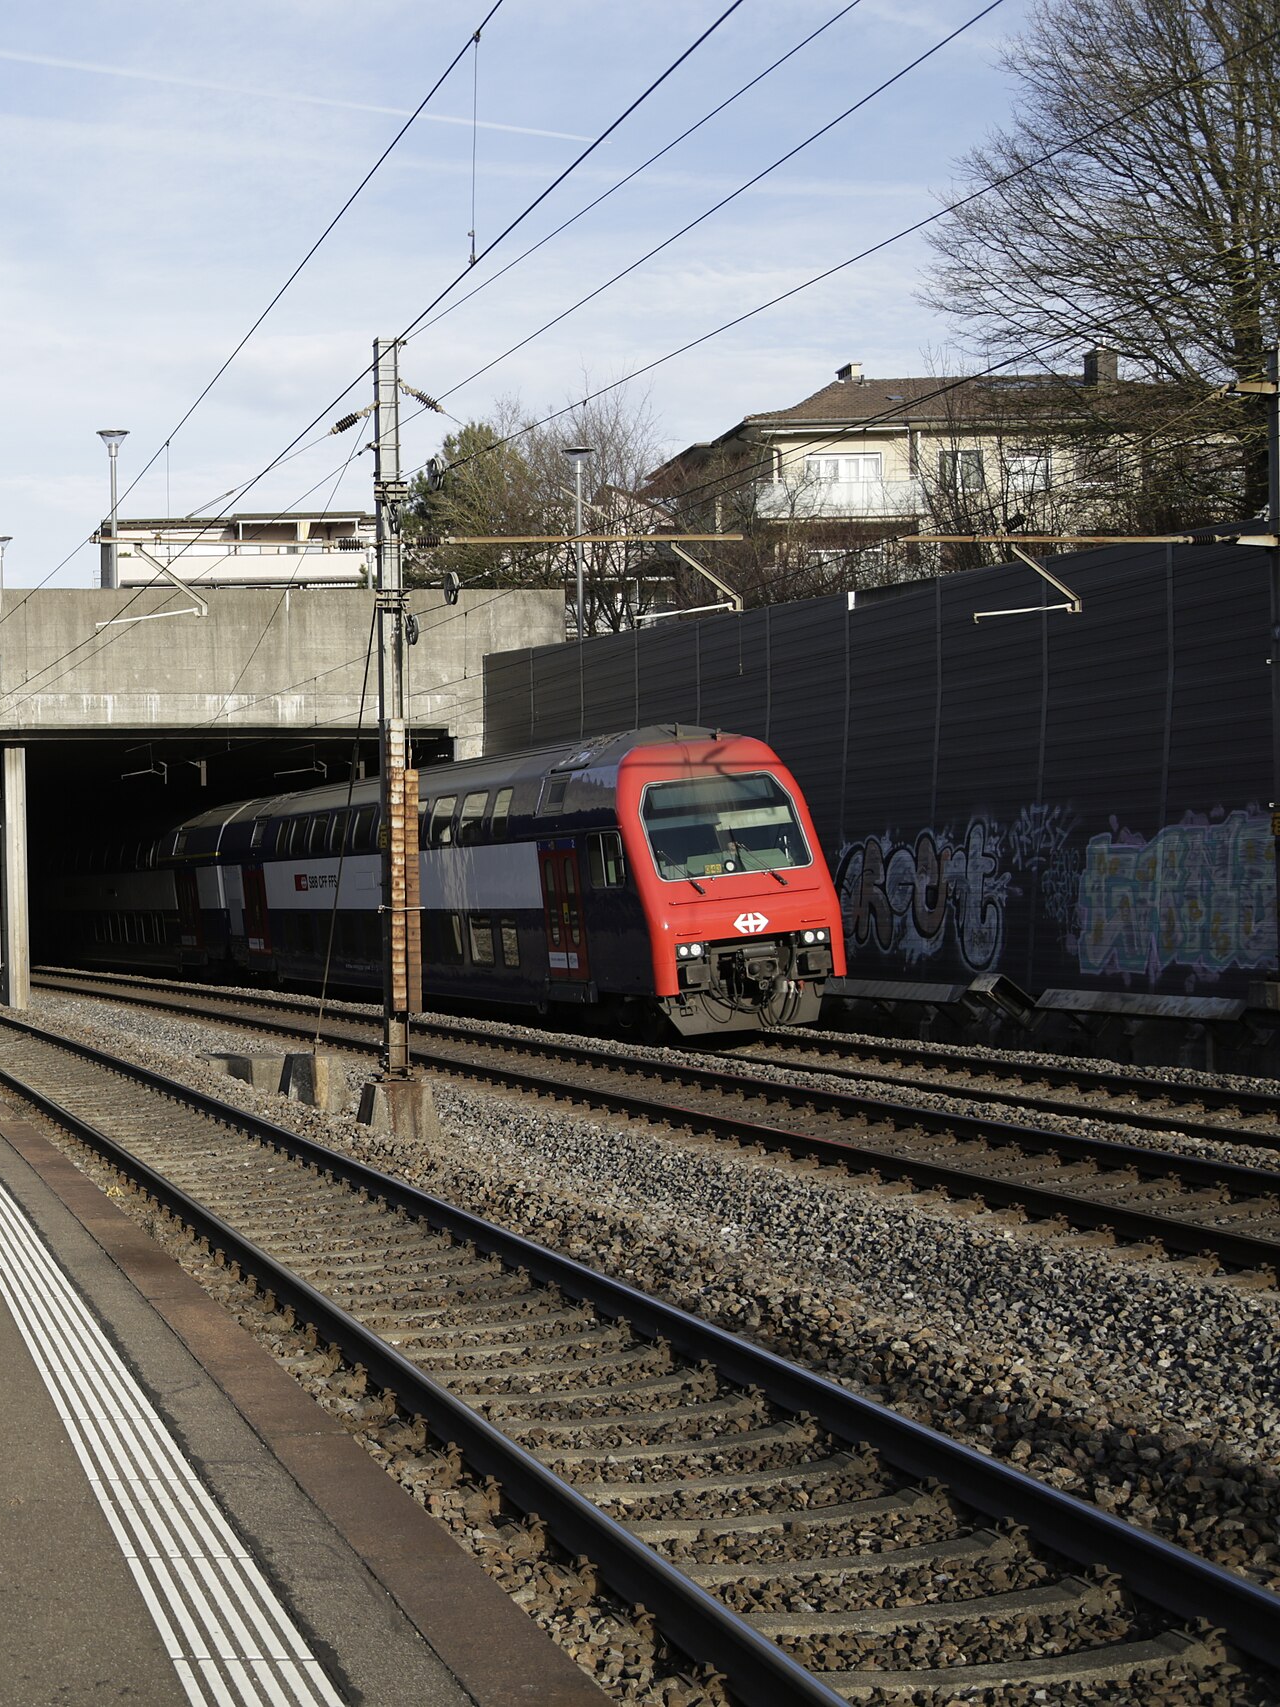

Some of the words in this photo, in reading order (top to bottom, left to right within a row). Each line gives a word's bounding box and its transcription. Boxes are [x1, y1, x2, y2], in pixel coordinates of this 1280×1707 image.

[309, 875, 318, 888] SBB
[319, 875, 327, 888] CFF
[328, 874, 338, 888] FFS
